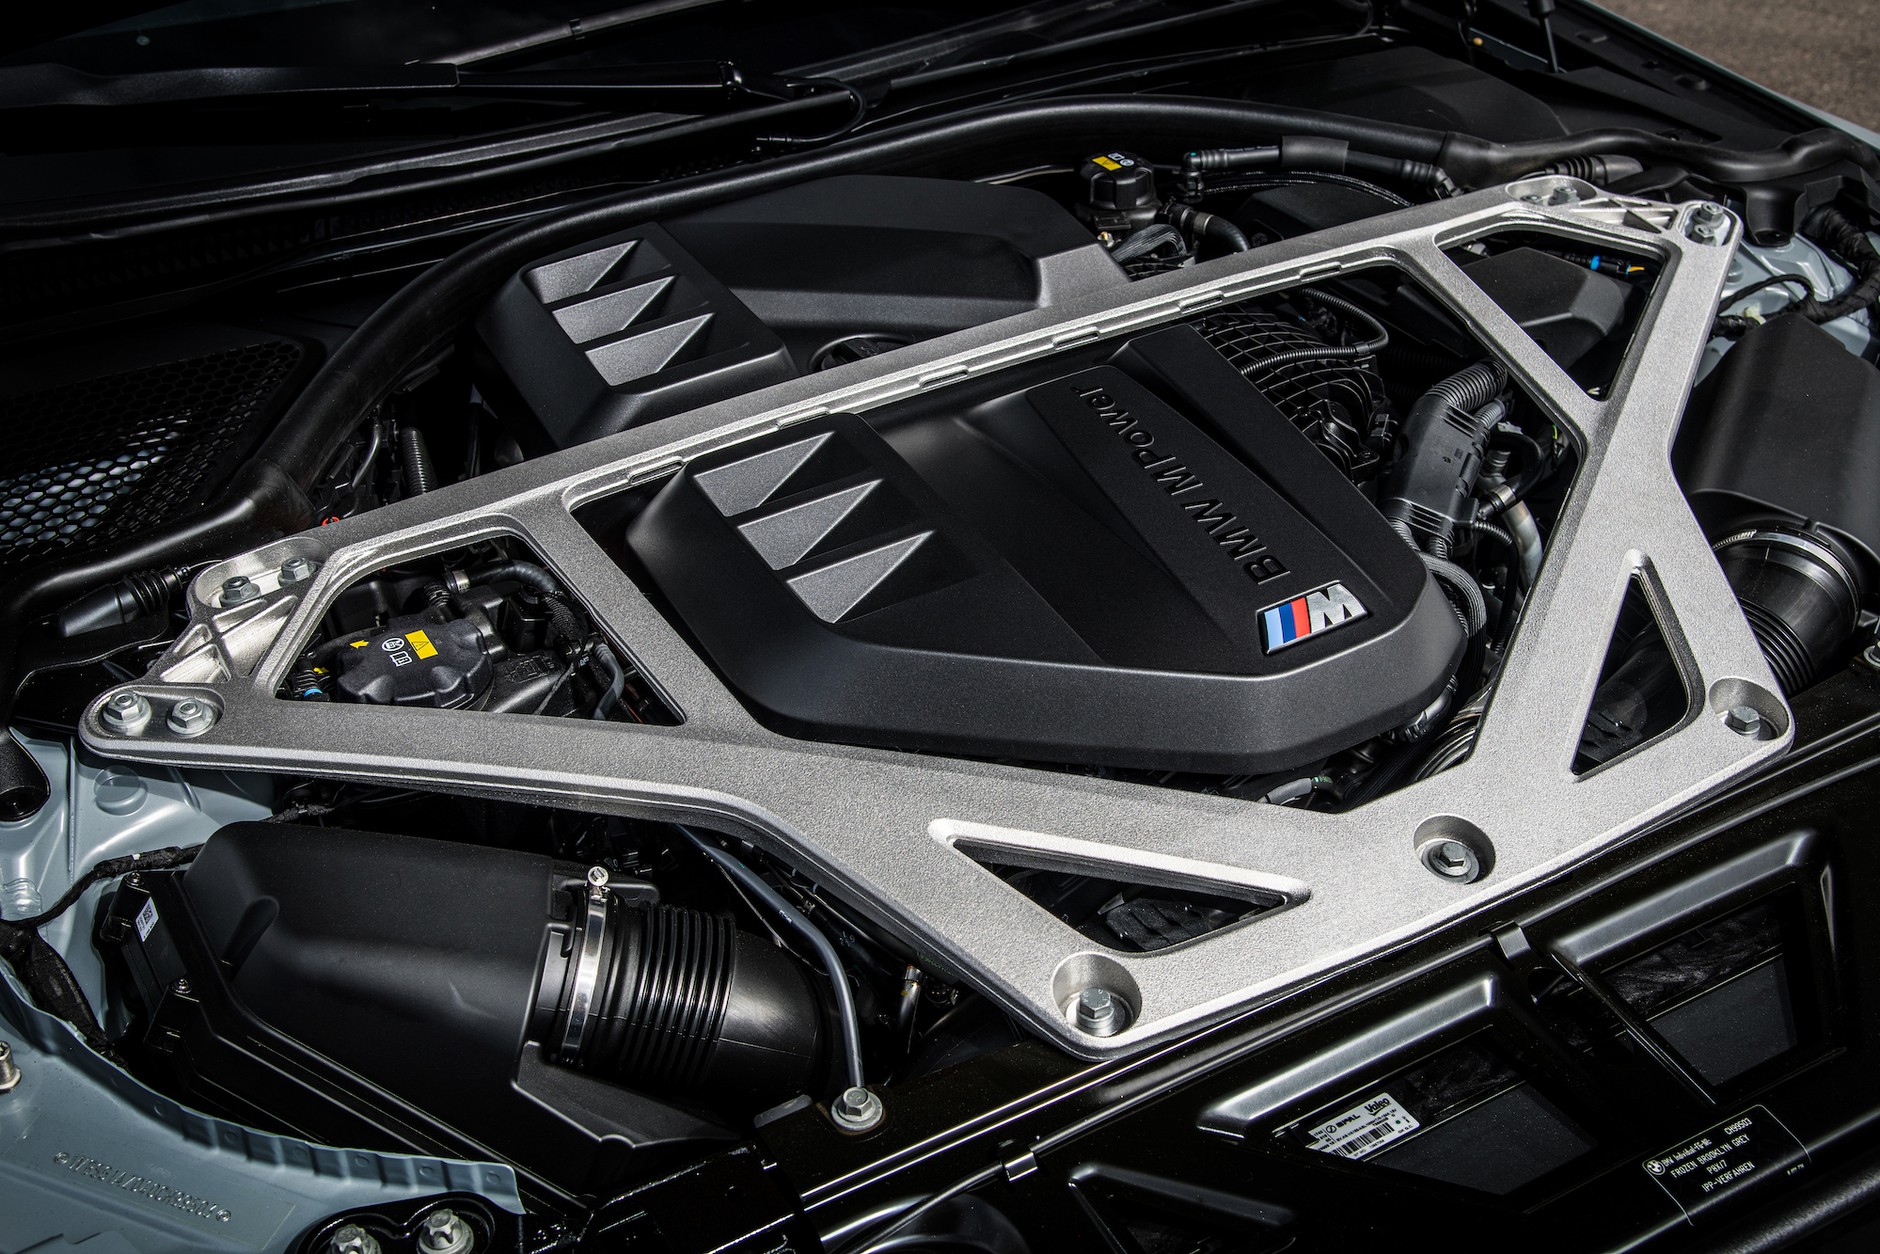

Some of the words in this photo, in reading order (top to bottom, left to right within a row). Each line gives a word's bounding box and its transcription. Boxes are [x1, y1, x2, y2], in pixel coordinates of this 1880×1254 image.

[1185, 499, 1291, 585] BMW
[1306, 583, 1367, 633] M
[1364, 1098, 1391, 1113] Valeo
[1670, 1160, 1699, 1179] FROZEN
[1696, 1143, 1733, 1166] BROOKLYN
[1731, 1133, 1751, 1148] GREY
[1701, 1161, 1756, 1193] IPP-VERFAHREN
